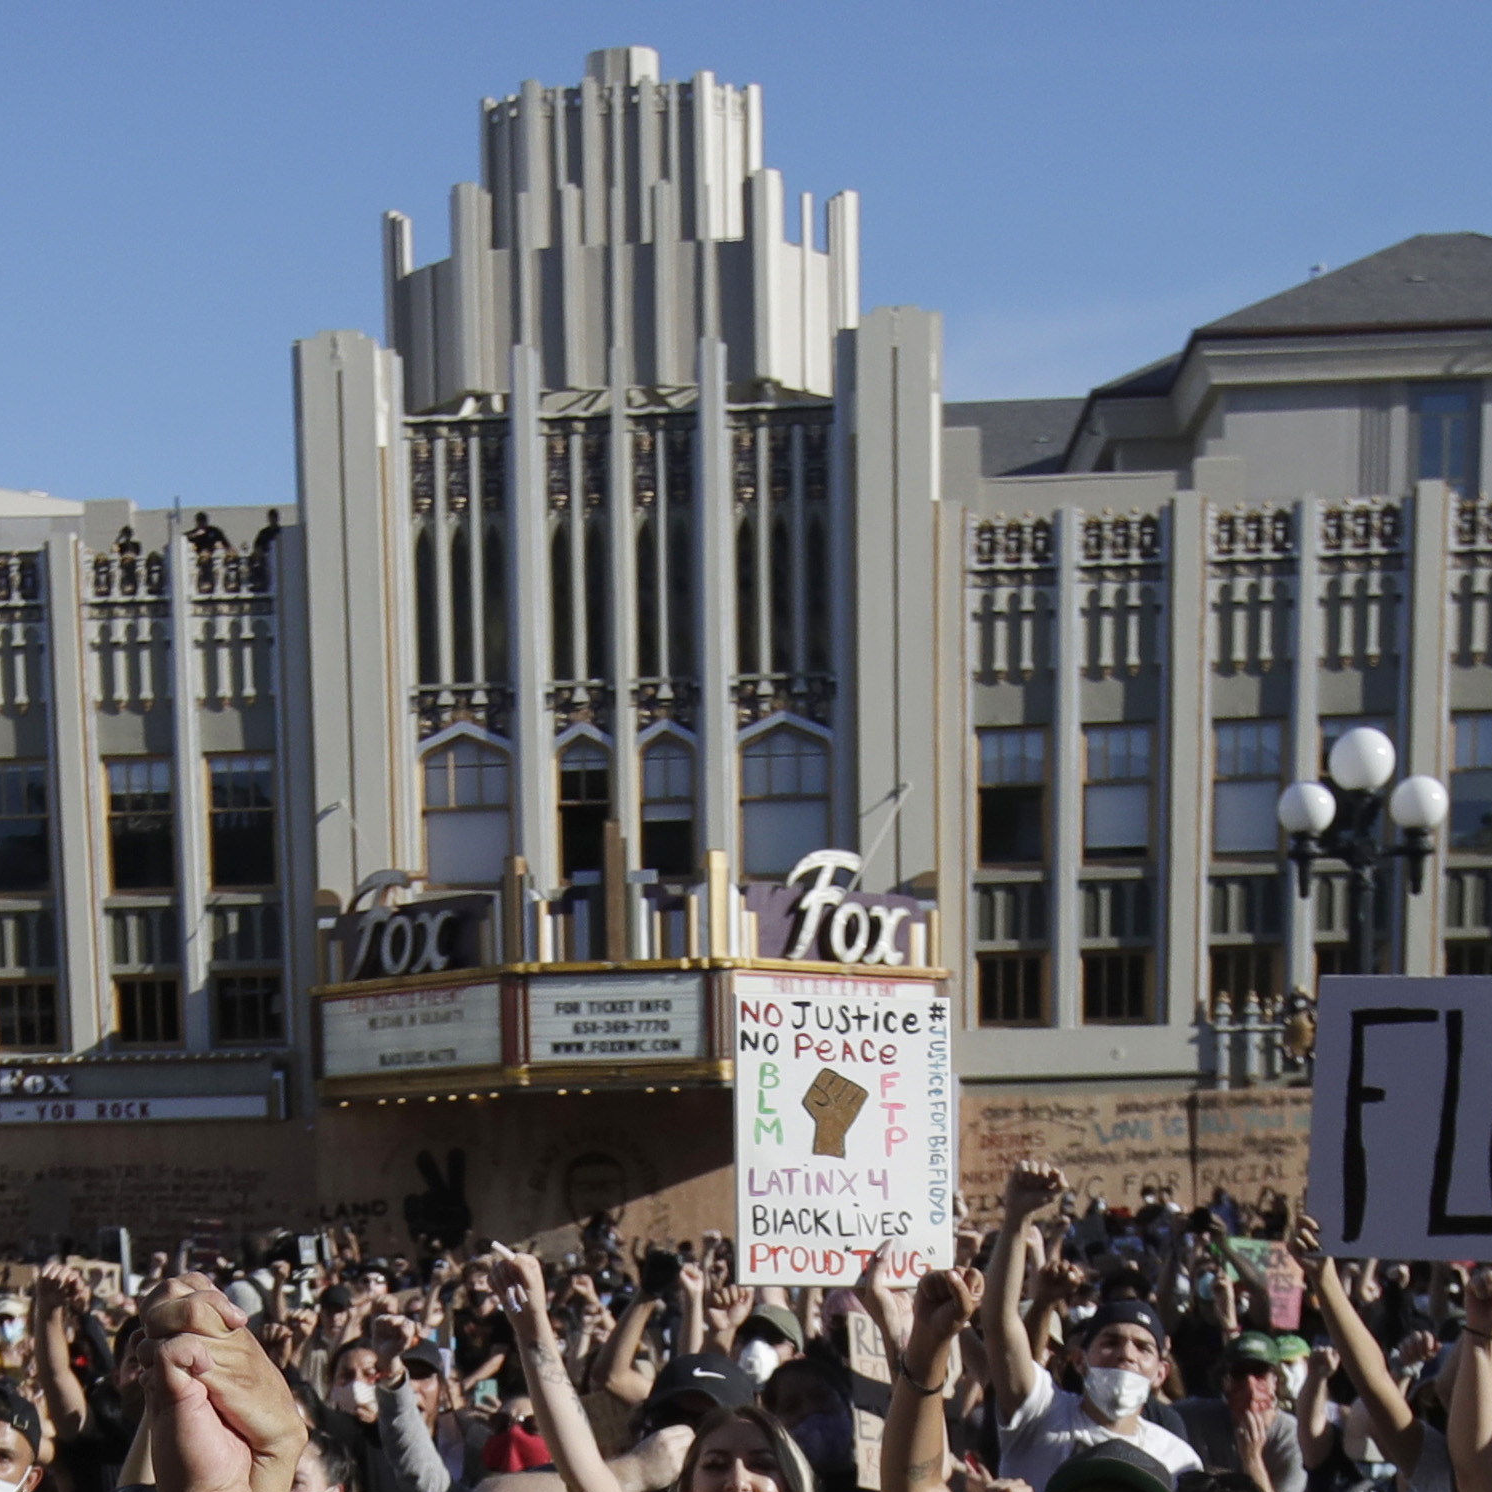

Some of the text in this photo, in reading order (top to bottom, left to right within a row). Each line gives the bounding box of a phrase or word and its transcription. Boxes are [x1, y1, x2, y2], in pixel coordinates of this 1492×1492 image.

[786, 849, 912, 966] Fox
[346, 869, 455, 980] Fox
[740, 1000, 783, 1027] NO
[740, 1030, 780, 1055] NO
[0, 1067, 72, 1096] Fox
[36, 1102, 77, 1120] YOU
[96, 1101, 151, 1119] ROCK
[867, 1168, 889, 1200] 4
[1200, 1161, 1287, 1187] RACIAL
